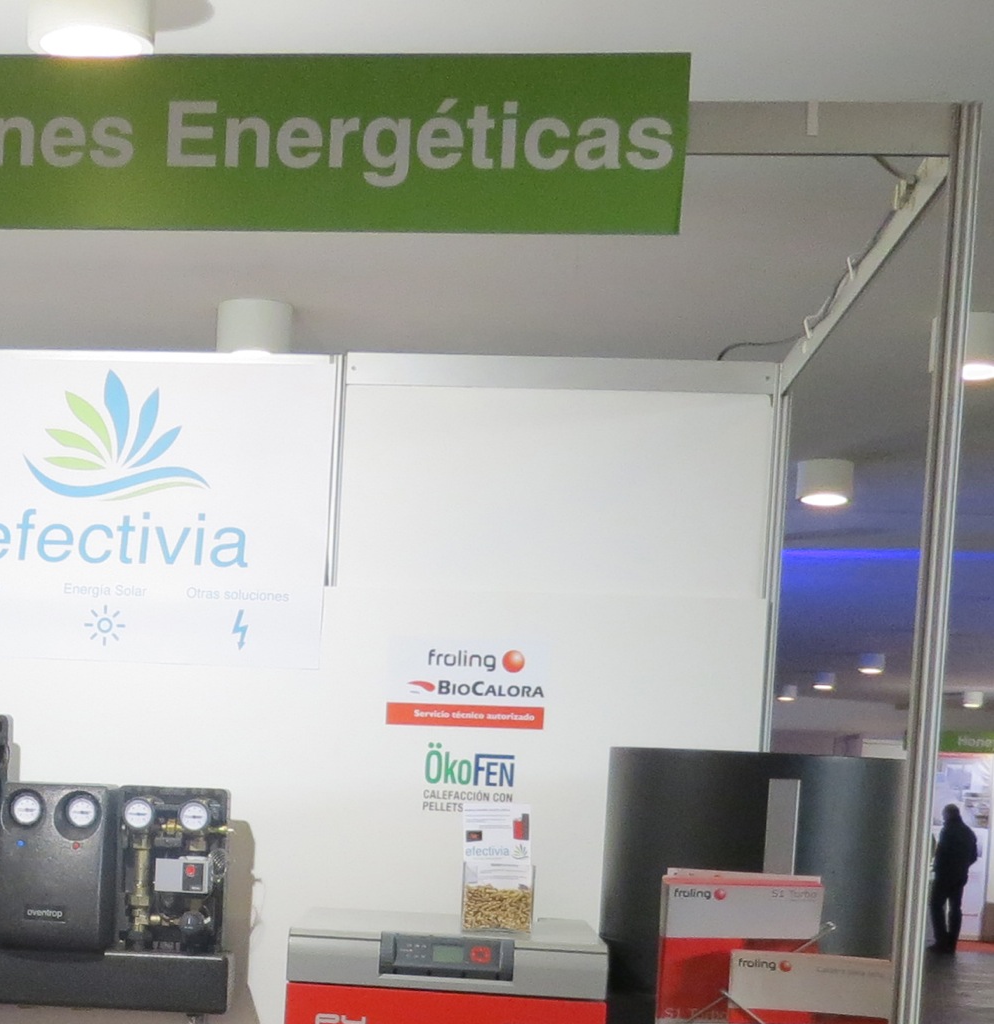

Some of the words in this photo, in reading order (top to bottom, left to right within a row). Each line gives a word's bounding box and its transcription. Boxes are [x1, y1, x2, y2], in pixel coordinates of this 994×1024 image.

[166, 98, 673, 188] Energéticas
[114, 584, 147, 597] Solar
[186, 587, 220, 600] Otras
[223, 589, 290, 602] soluciones
[414, 709, 450, 719] Servicio
[452, 710, 485, 720] técnico
[486, 712, 535, 722] autorizado
[423, 789, 490, 802] CALEFACCIÓN
[492, 792, 513, 803] CON
[422, 801, 464, 813] PELLETS
[465, 846, 510, 858] efectivia
[27, 909, 63, 919] oventrop
